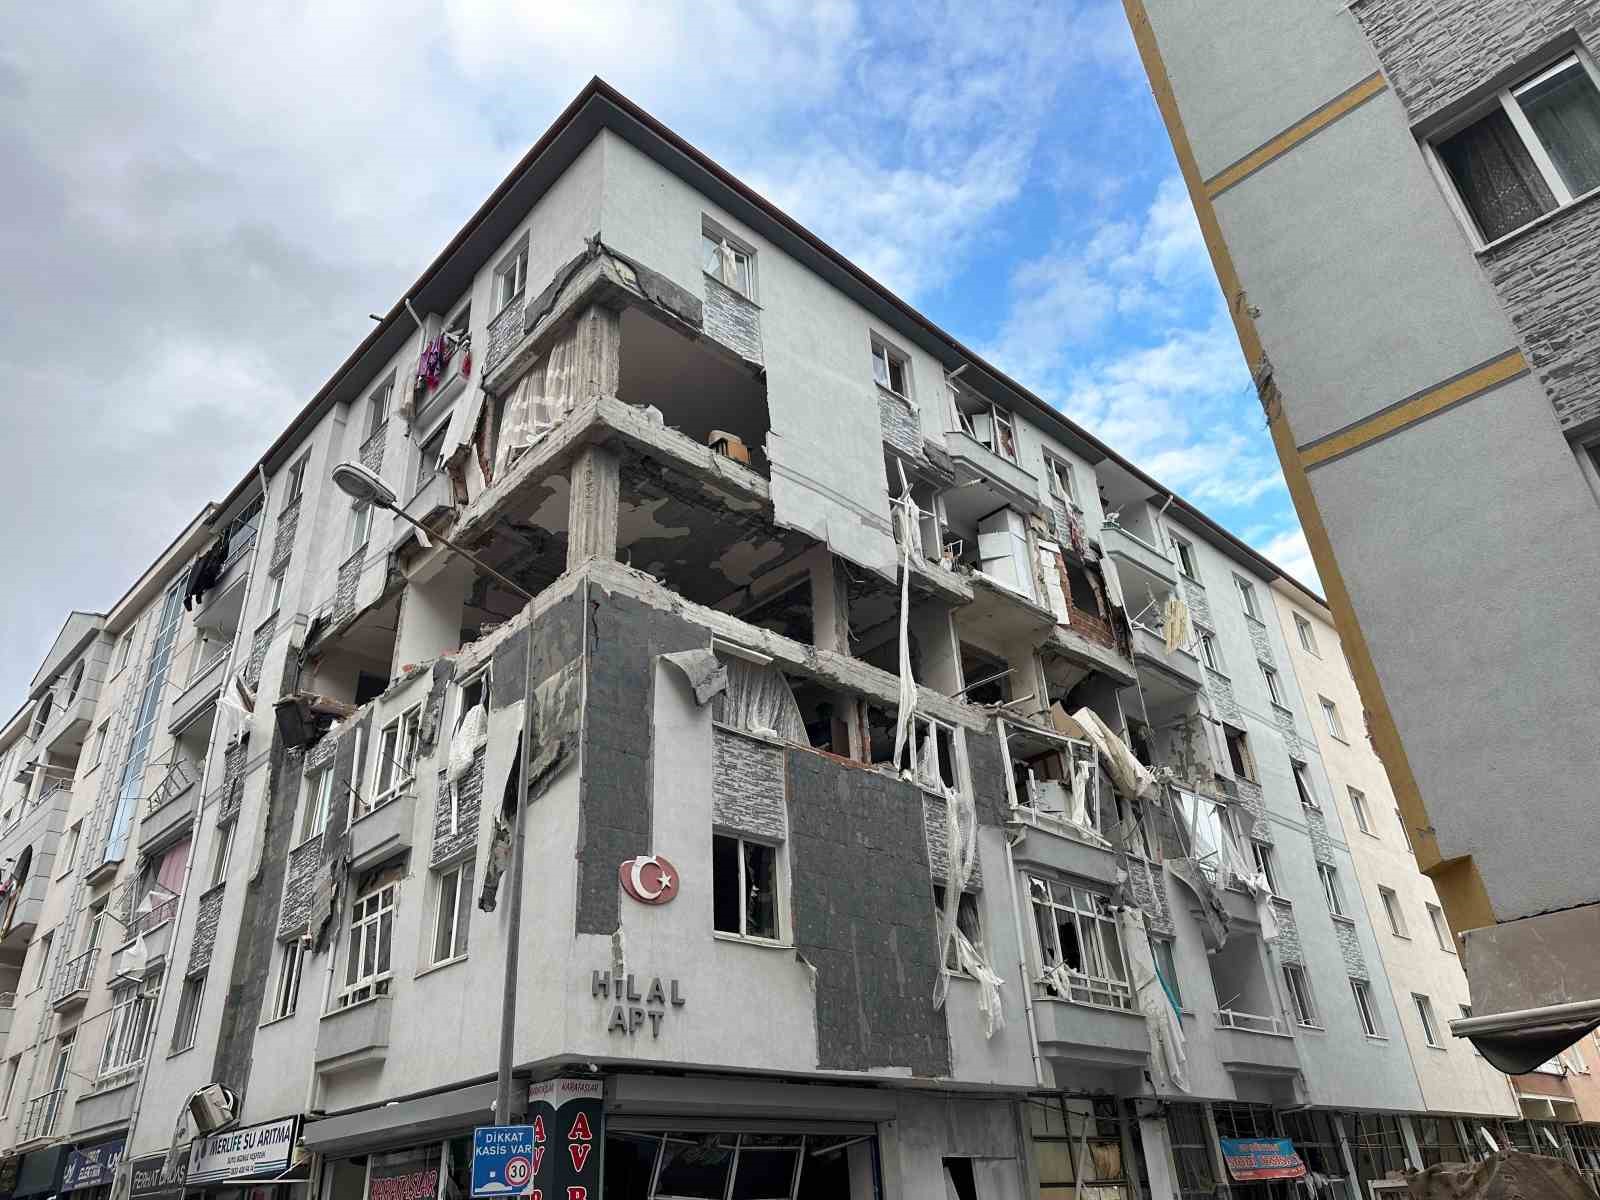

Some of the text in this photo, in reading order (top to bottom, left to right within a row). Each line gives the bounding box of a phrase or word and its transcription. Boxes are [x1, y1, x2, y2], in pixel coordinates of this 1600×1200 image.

[608, 1006, 664, 1038] APT
[243, 1132, 257, 1150] SU
[511, 1144, 532, 1154] VAR
[510, 1165, 526, 1178] 30
